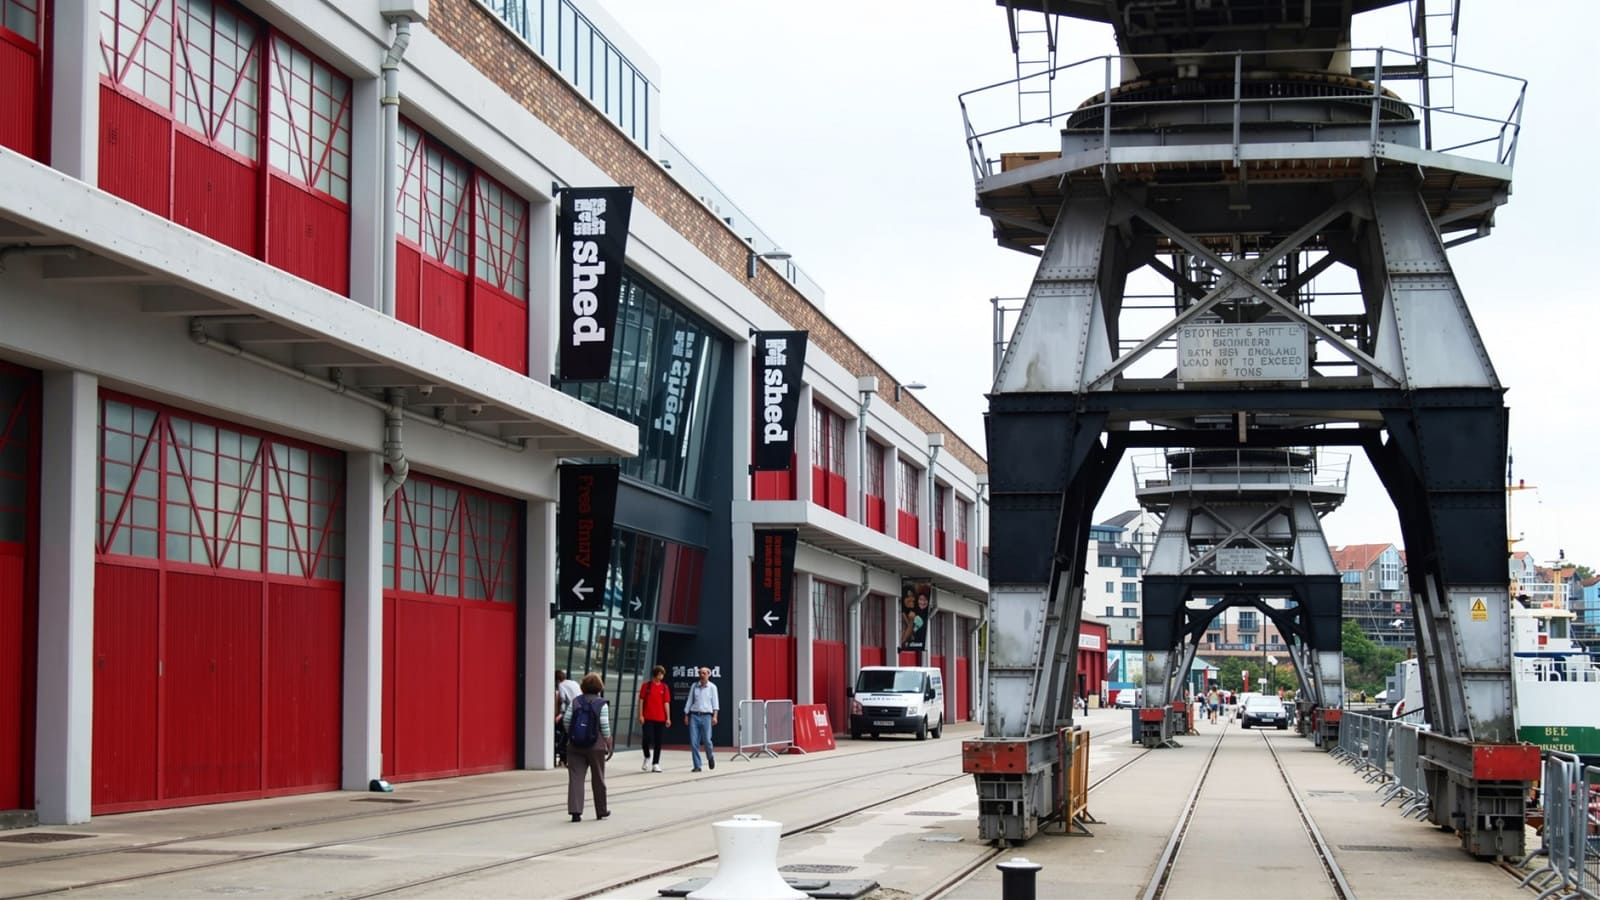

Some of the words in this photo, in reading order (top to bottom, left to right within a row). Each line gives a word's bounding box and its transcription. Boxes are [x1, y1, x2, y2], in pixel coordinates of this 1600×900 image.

[574, 198, 607, 236] M
[572, 241, 606, 346] shed
[765, 338, 787, 366] M
[1215, 357, 1233, 366] NOT
[1242, 357, 1254, 366] TO
[1260, 356, 1302, 366] EXCEED
[1234, 367, 1263, 377] TONS
[764, 369, 789, 445] shed
